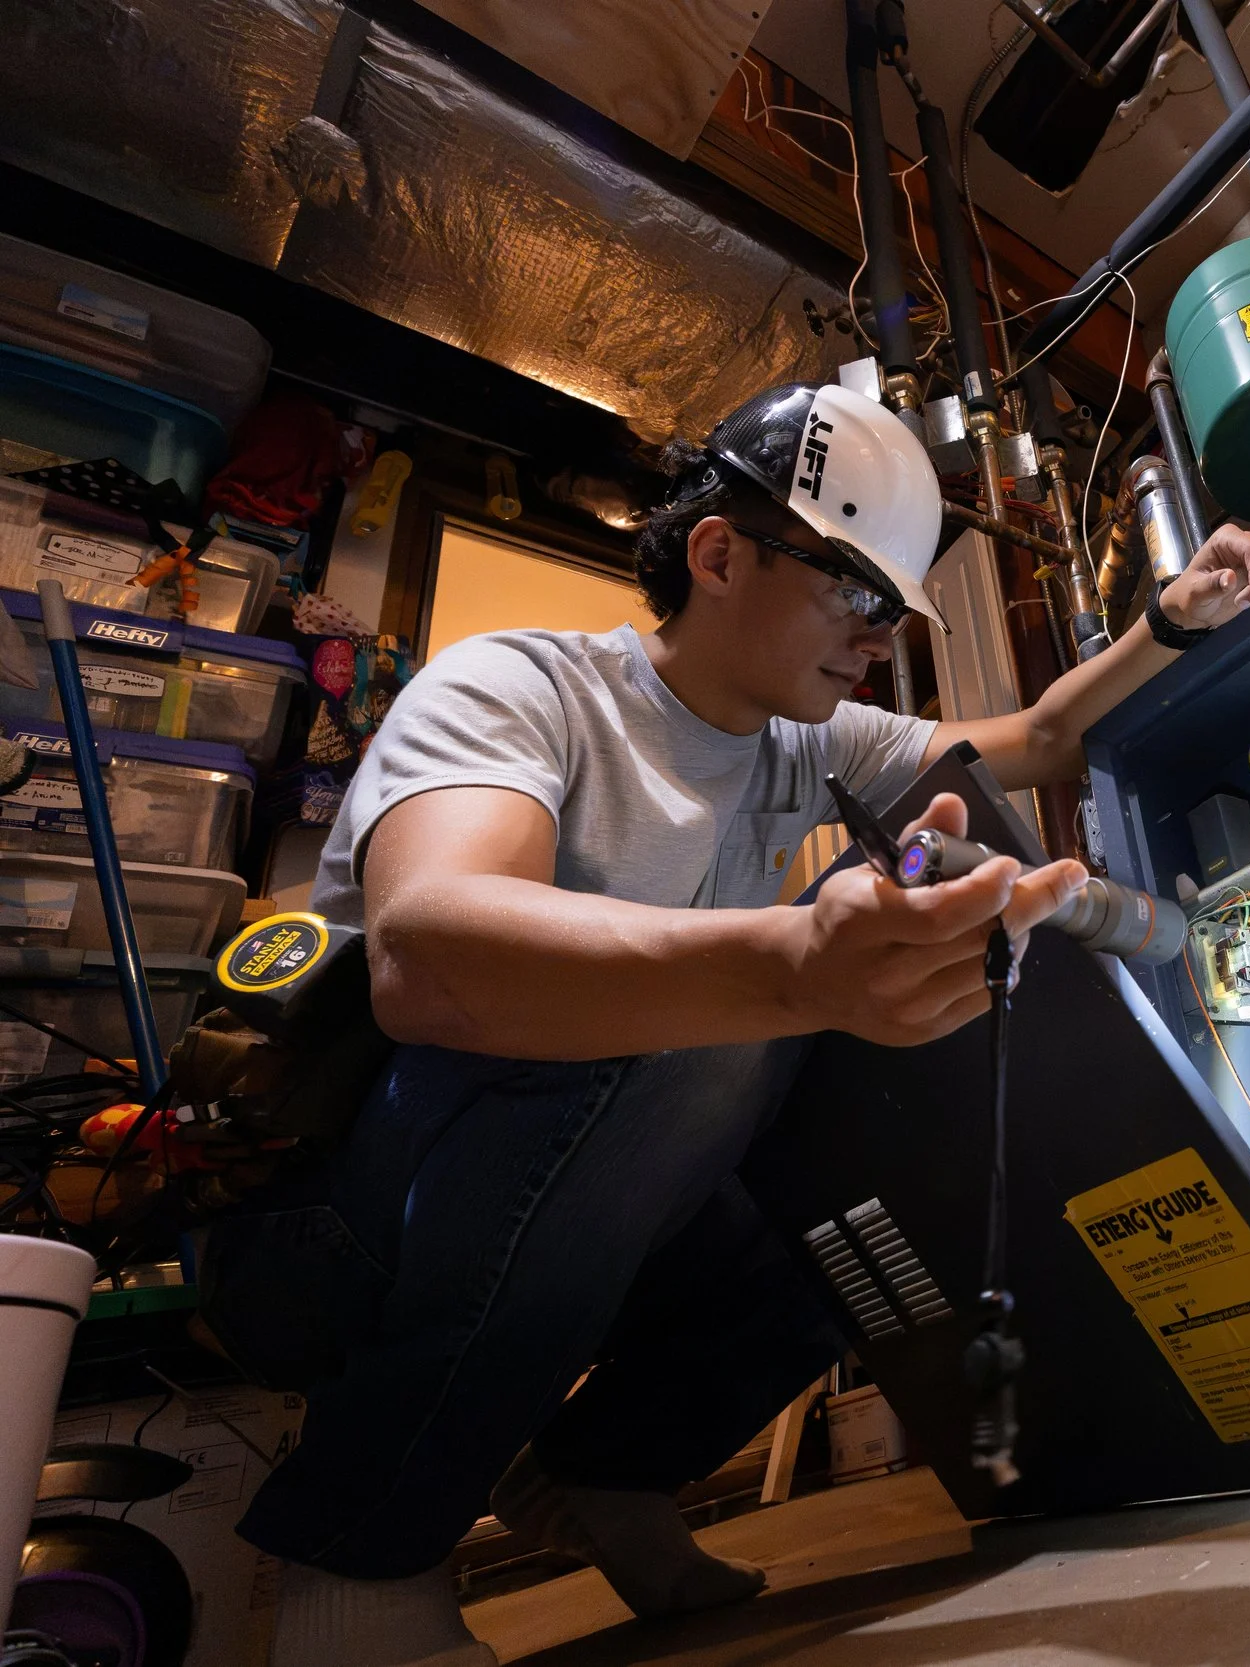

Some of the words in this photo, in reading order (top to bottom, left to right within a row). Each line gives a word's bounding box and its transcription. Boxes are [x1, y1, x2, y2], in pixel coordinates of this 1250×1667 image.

[798, 416, 834, 501] LIFT
[94, 623, 162, 645] Hefty
[18, 735, 72, 754] Heft
[240, 928, 290, 974] STANLEY
[254, 932, 299, 975] FATMAX
[1085, 1180, 1218, 1248] ENERGYGUIDE
